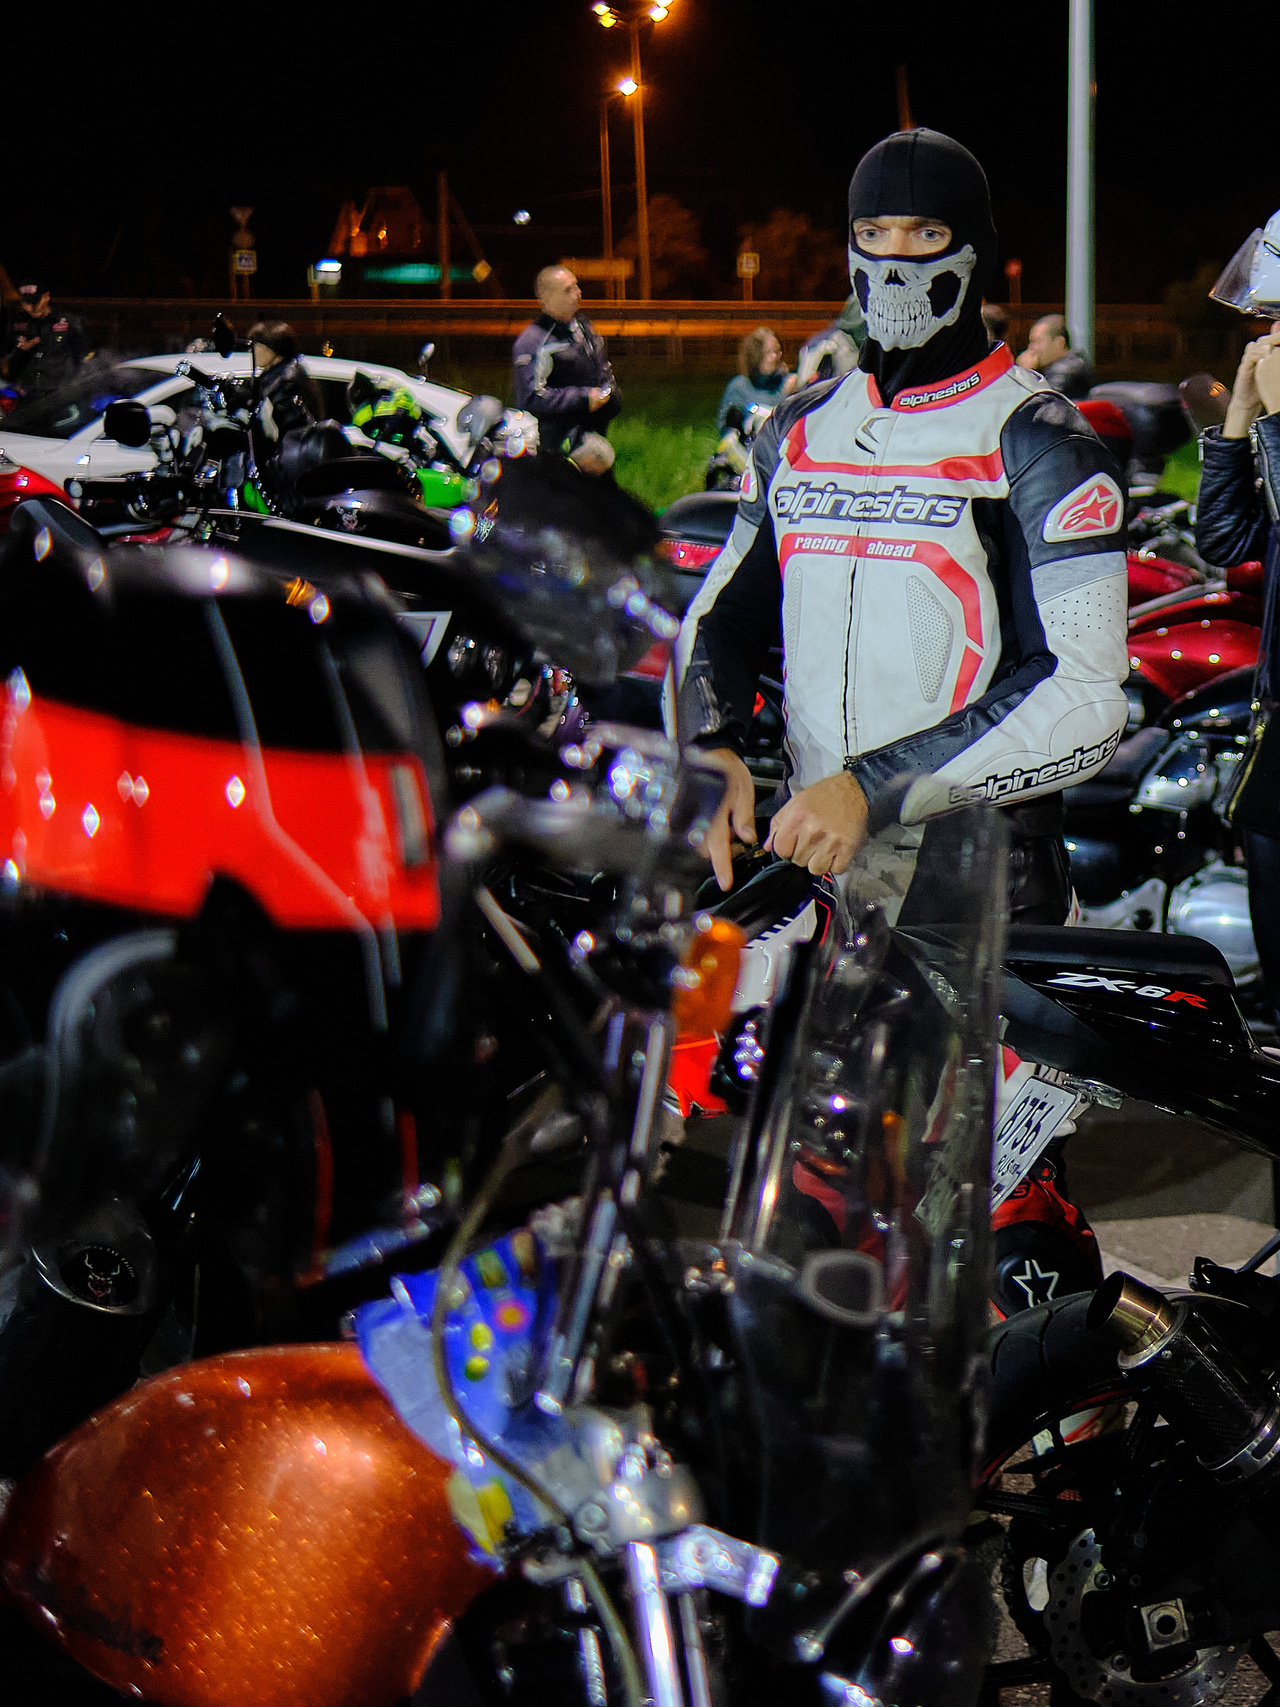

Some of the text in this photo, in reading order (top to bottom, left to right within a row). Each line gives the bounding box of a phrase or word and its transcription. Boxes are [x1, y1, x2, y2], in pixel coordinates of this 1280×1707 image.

[899, 371, 981, 407] alpinestars
[776, 482, 966, 527] alpinestars
[794, 536, 916, 558] racing ahead
[1047, 972, 1208, 1010] ZX-6R
[997, 1095, 1054, 1155] 8756
